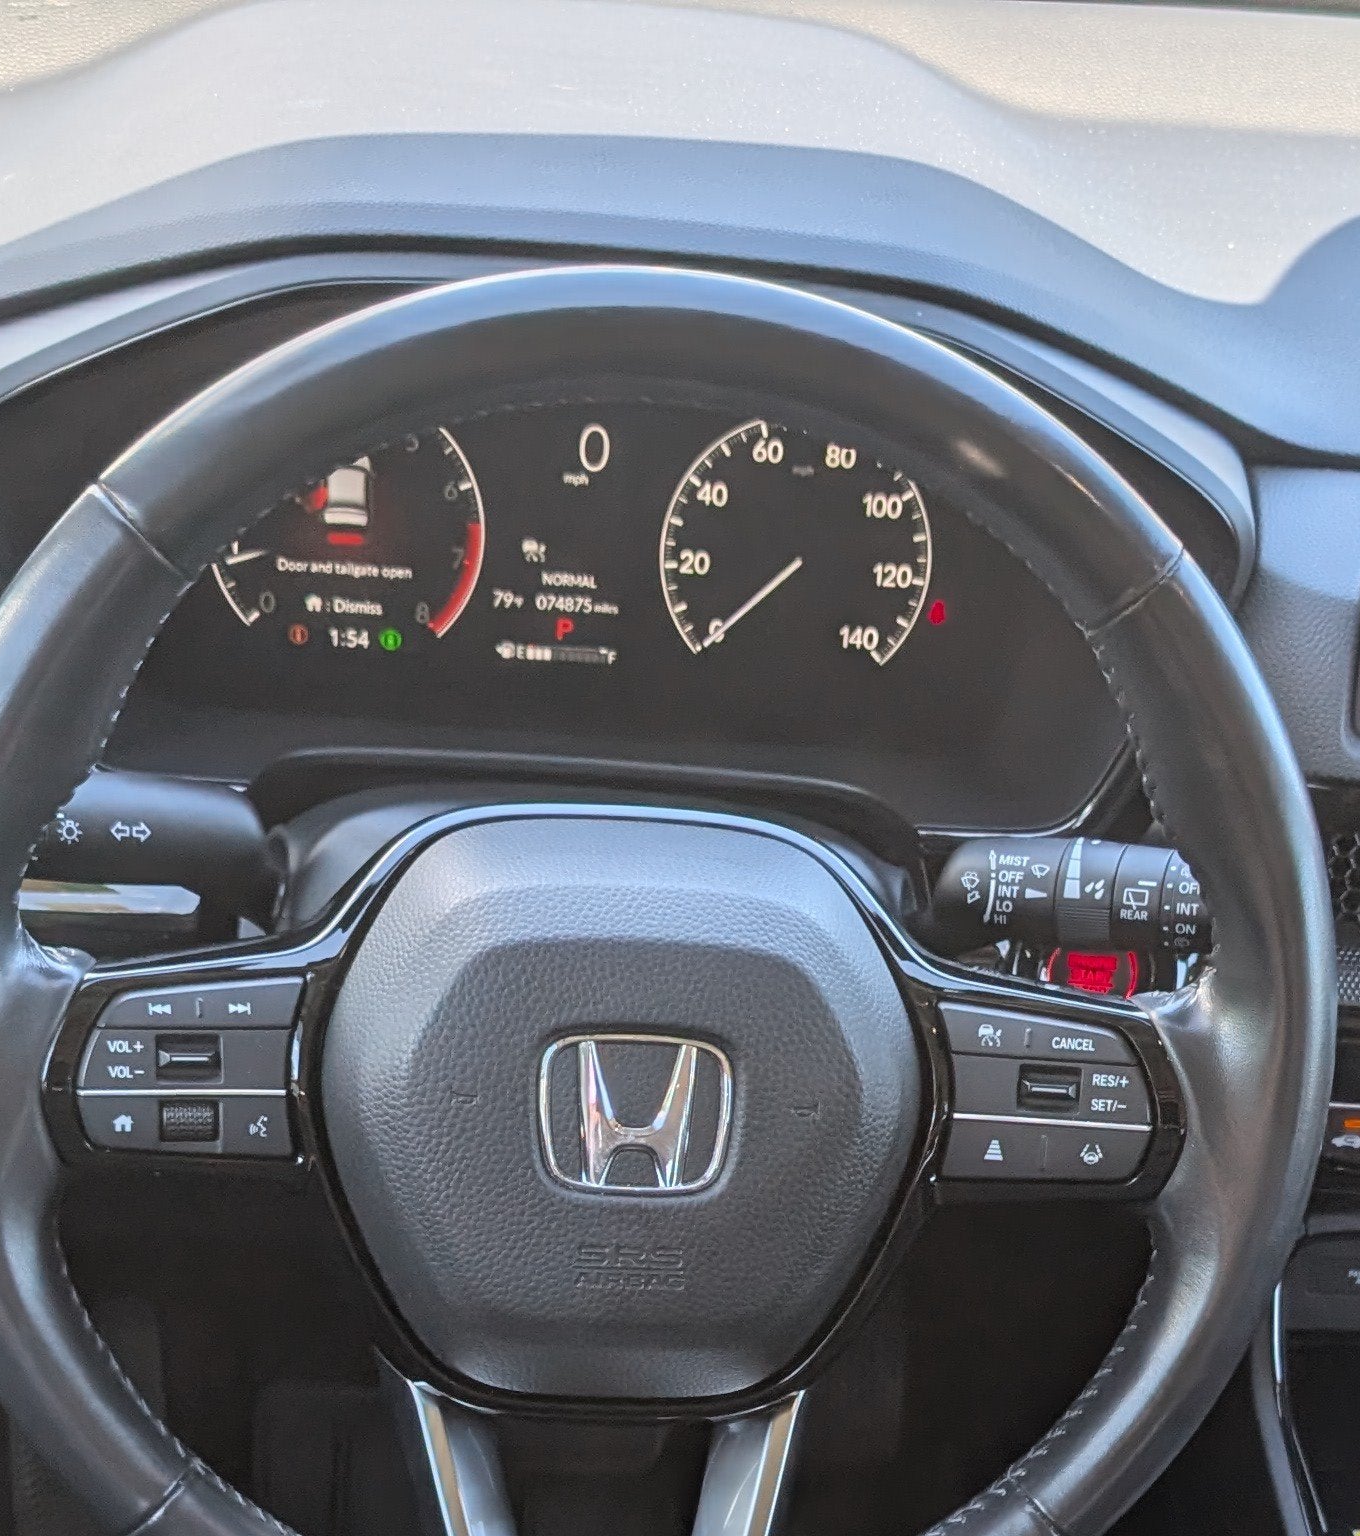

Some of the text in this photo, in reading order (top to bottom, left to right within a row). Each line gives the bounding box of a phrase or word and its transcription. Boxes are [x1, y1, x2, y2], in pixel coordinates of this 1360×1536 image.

[579, 423, 610, 472] 0
[752, 439, 784, 464] 60
[825, 442, 857, 469] 80
[563, 472, 589, 487] mph
[445, 480, 458, 500] 6
[696, 480, 728, 507] 40
[863, 493, 902, 519] 100
[276, 557, 413, 580] Door and tailgate open
[680, 550, 711, 575] 20
[541, 571, 597, 589] NORMAL
[873, 562, 913, 589] 120
[259, 590, 276, 614] 0
[332, 597, 383, 616] Dismiss
[535, 593, 593, 613] 074875
[594, 603, 620, 616] miles
[415, 601, 430, 624] 8
[329, 627, 370, 649] 1:54
[554, 617, 574, 641] P
[839, 625, 880, 650] 140
[999, 854, 1030, 867] MIST
[998, 870, 1024, 883] OFF
[997, 885, 1019, 899] INT
[1178, 881, 1200, 896] OF
[995, 899, 1013, 913] LO
[1120, 908, 1148, 921] REAR
[1175, 902, 1199, 916] INT
[993, 913, 1007, 925] HI
[1174, 922, 1197, 935] ON
[1051, 1036, 1096, 1052] CANCEL
[1091, 1073, 1130, 1088] RES/+
